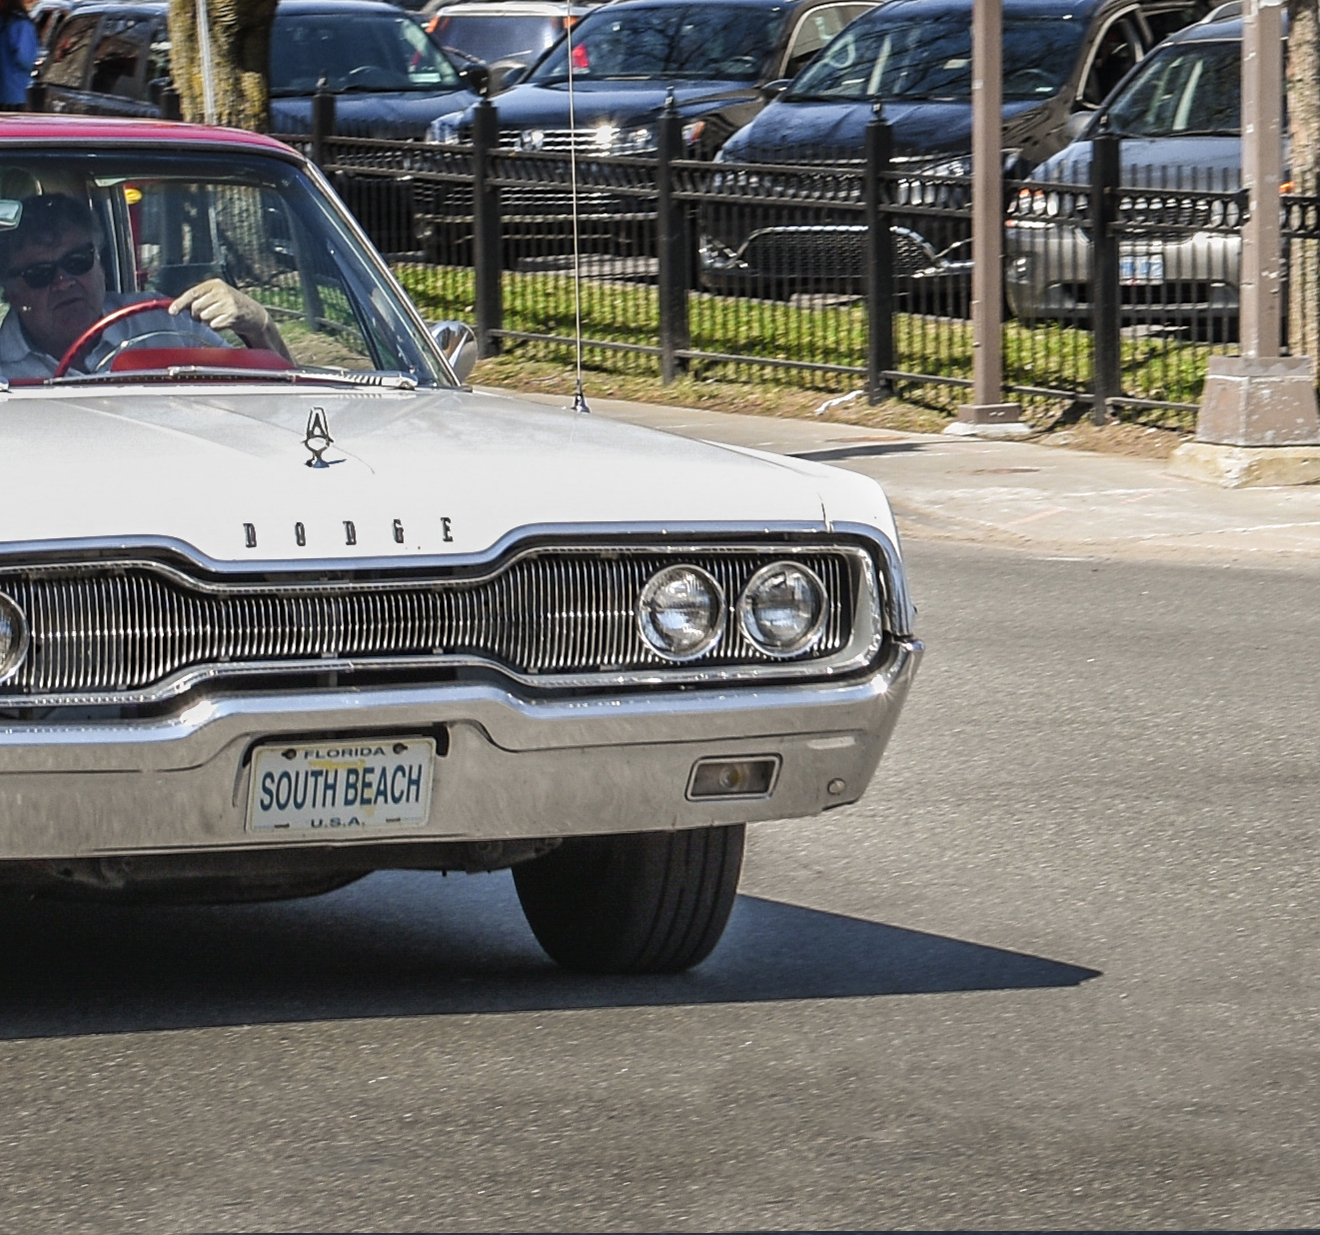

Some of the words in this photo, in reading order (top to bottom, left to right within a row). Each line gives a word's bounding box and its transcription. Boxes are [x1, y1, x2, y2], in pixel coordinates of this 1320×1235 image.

[243, 517, 453, 548] DODGE
[304, 746, 386, 759] FLORIDA
[260, 768, 339, 812] SOUTH
[343, 763, 423, 806] BEACH
[310, 816, 366, 828] U.S.A.
